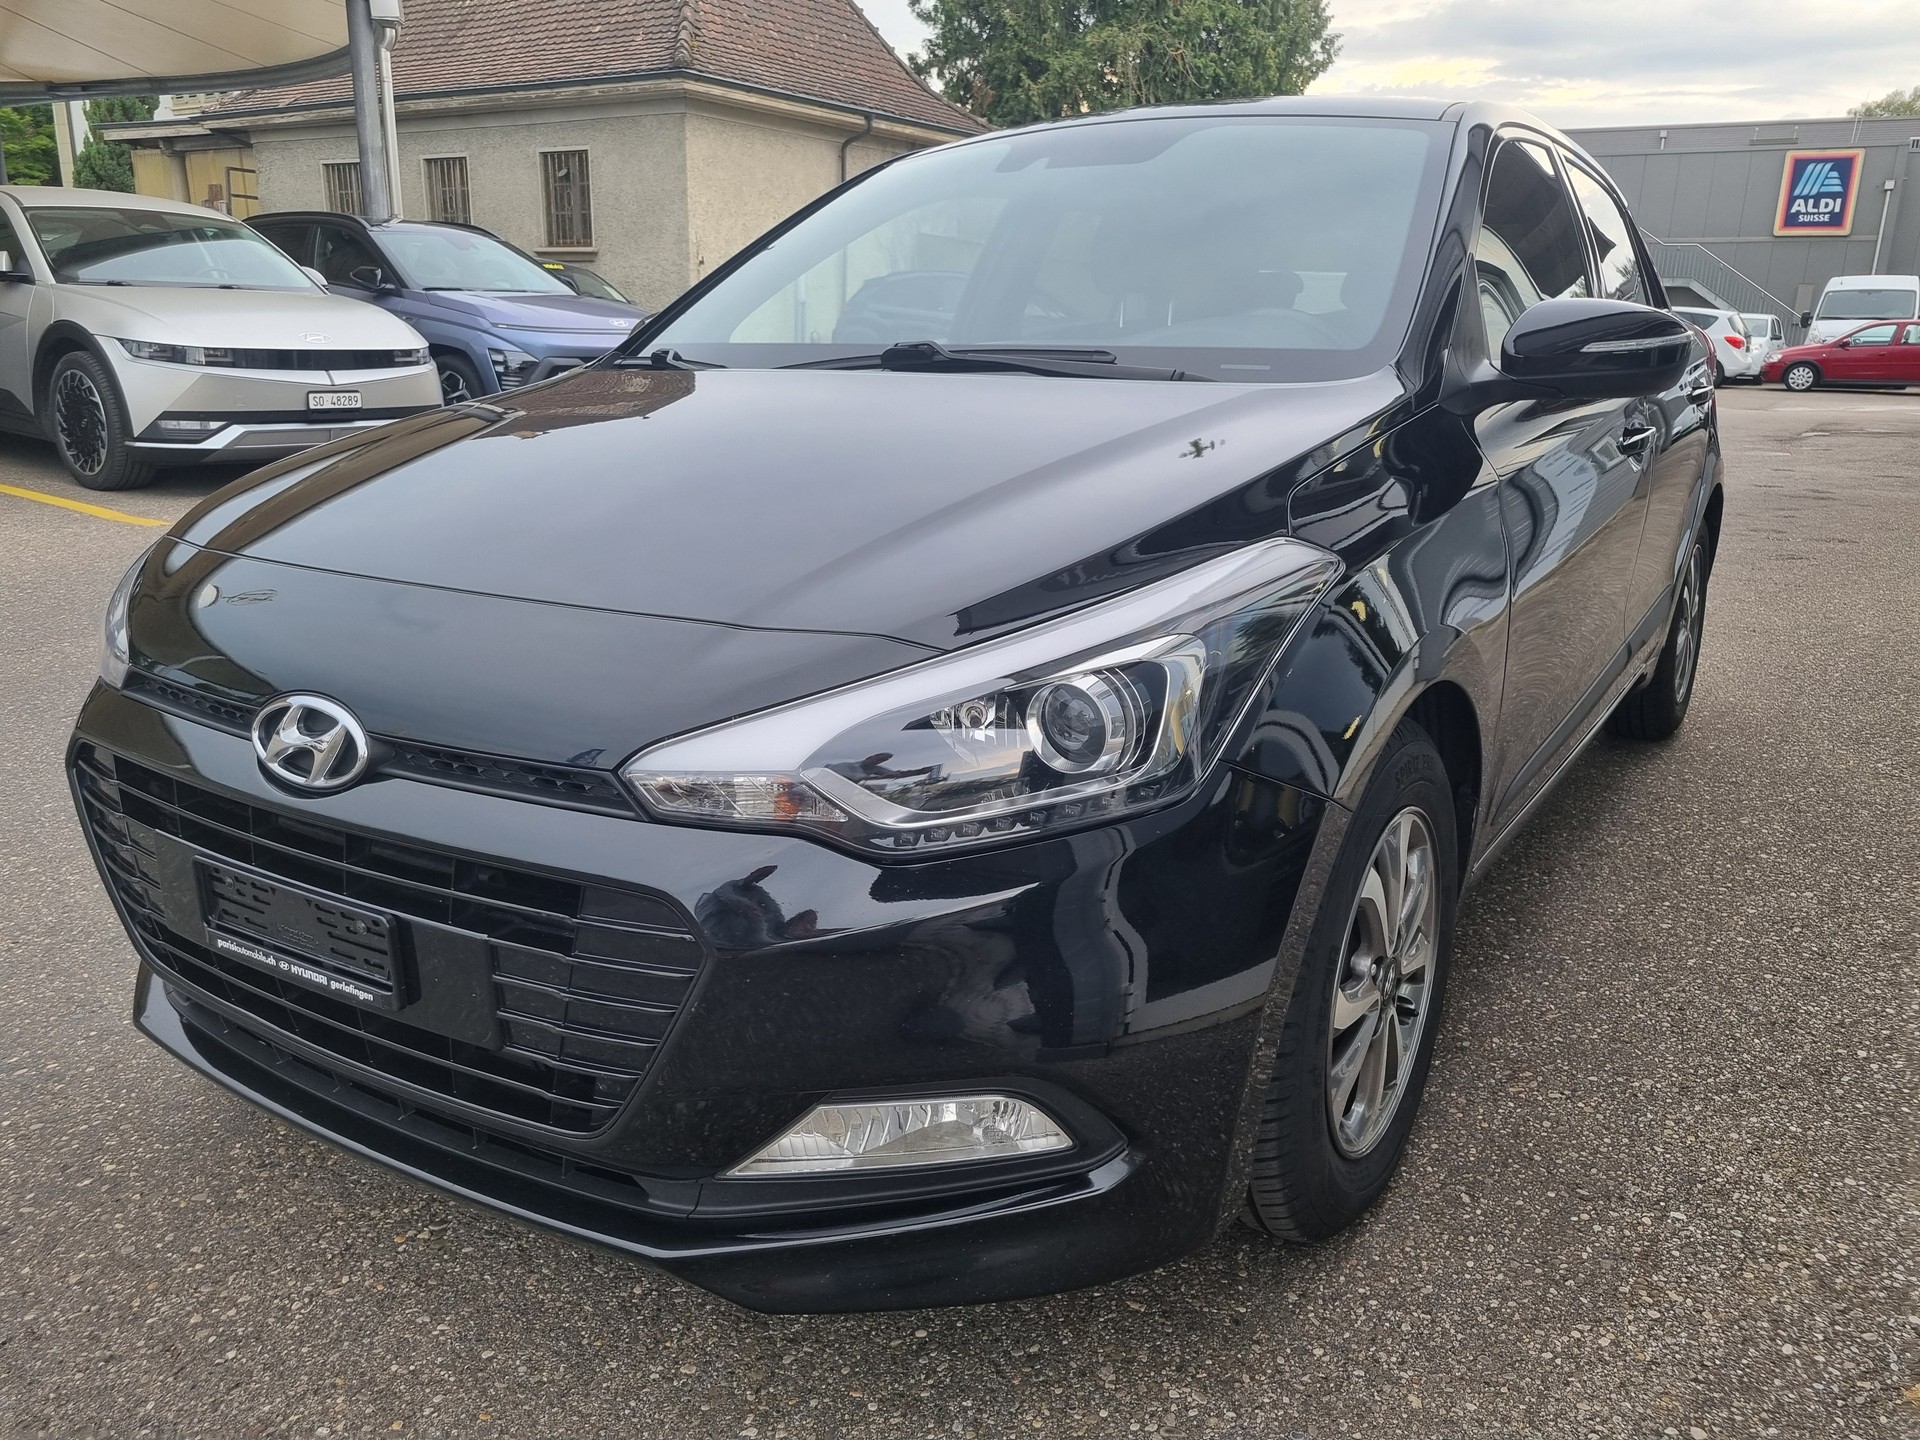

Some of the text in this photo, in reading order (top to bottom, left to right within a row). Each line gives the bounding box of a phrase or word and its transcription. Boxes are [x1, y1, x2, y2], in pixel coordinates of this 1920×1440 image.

[1790, 198, 1842, 213] ALDI
[1798, 214, 1830, 222] SUISSE
[290, 964, 328, 986] HYUNDAI
[330, 980, 374, 1002] gerlafingen
